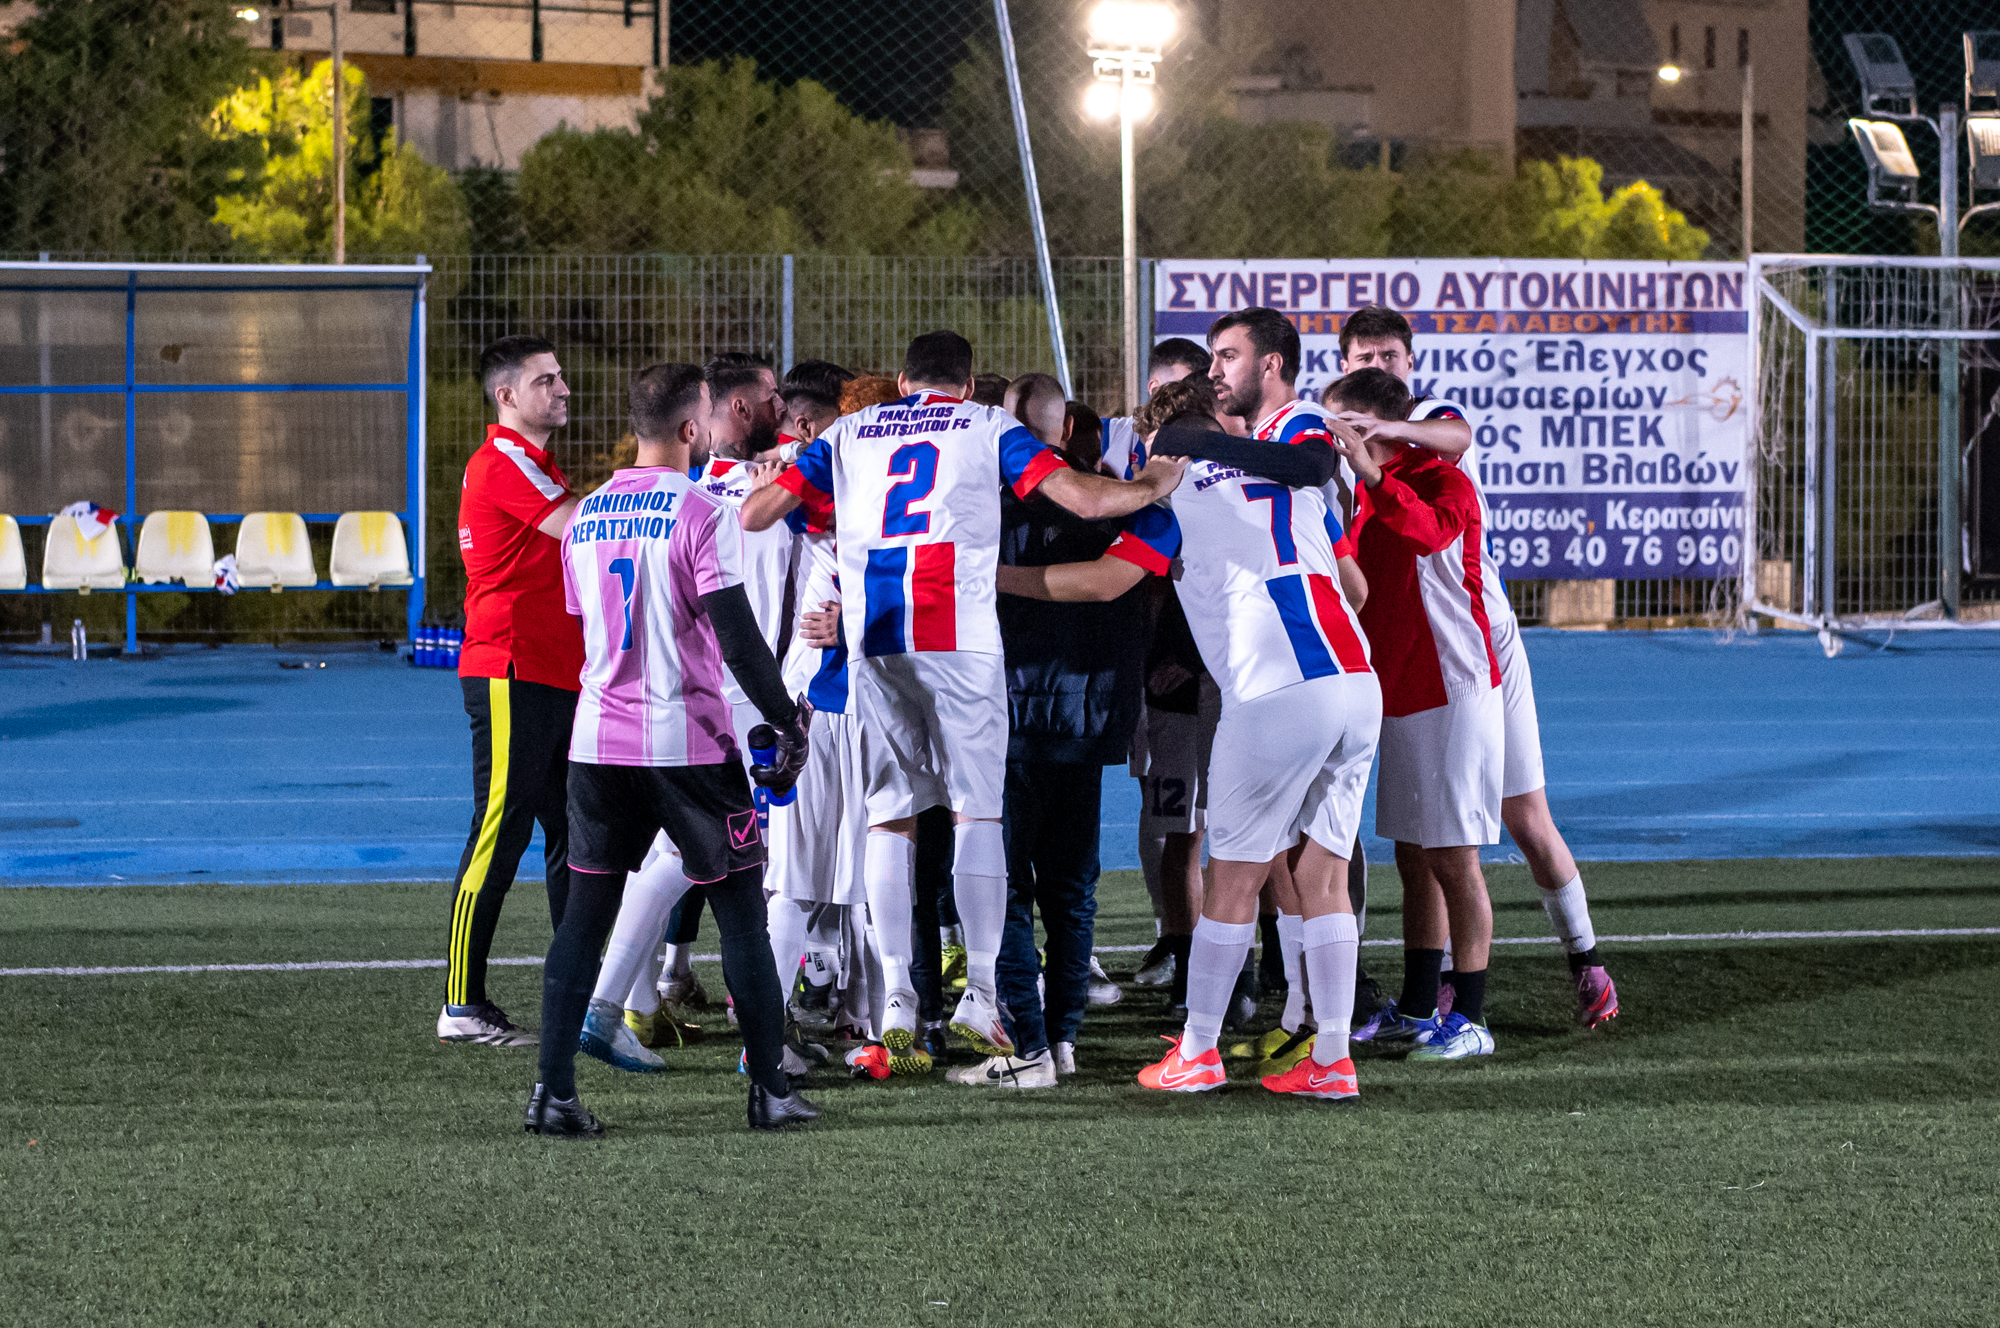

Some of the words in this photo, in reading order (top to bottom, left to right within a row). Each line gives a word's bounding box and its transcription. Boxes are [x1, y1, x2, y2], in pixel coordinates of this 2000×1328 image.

[1168, 271, 1421, 309] ΣΥΝΕΡΓΕΙΟ
[1435, 271, 1744, 310] ΑΥΤΟΚΙΝΗΤΩΝ
[1430, 313, 1691, 333] ΤΣΑΛΑΒΟΥΤΗΣ
[1526, 340, 1709, 378] Έλεγχος
[856, 419, 950, 440] KERATSINIOU
[951, 418, 971, 430] FC
[876, 406, 955, 424] PANIONIOS
[1540, 416, 1666, 448] ΜΠΕΚ
[1582, 452, 1739, 486] Βλαβών
[581, 491, 677, 517] ΠΑΝΙΩΝΙΟΣ
[881, 440, 940, 538] 2
[1240, 483, 1298, 566] 7
[1605, 499, 1742, 536] Κερατσίνι
[1493, 536, 1551, 567] 693
[1563, 536, 1606, 567] 40
[1621, 536, 1663, 566] 76
[1676, 535, 1740, 566] 960
[608, 558, 635, 650] 1
[1151, 777, 1187, 817] 12
